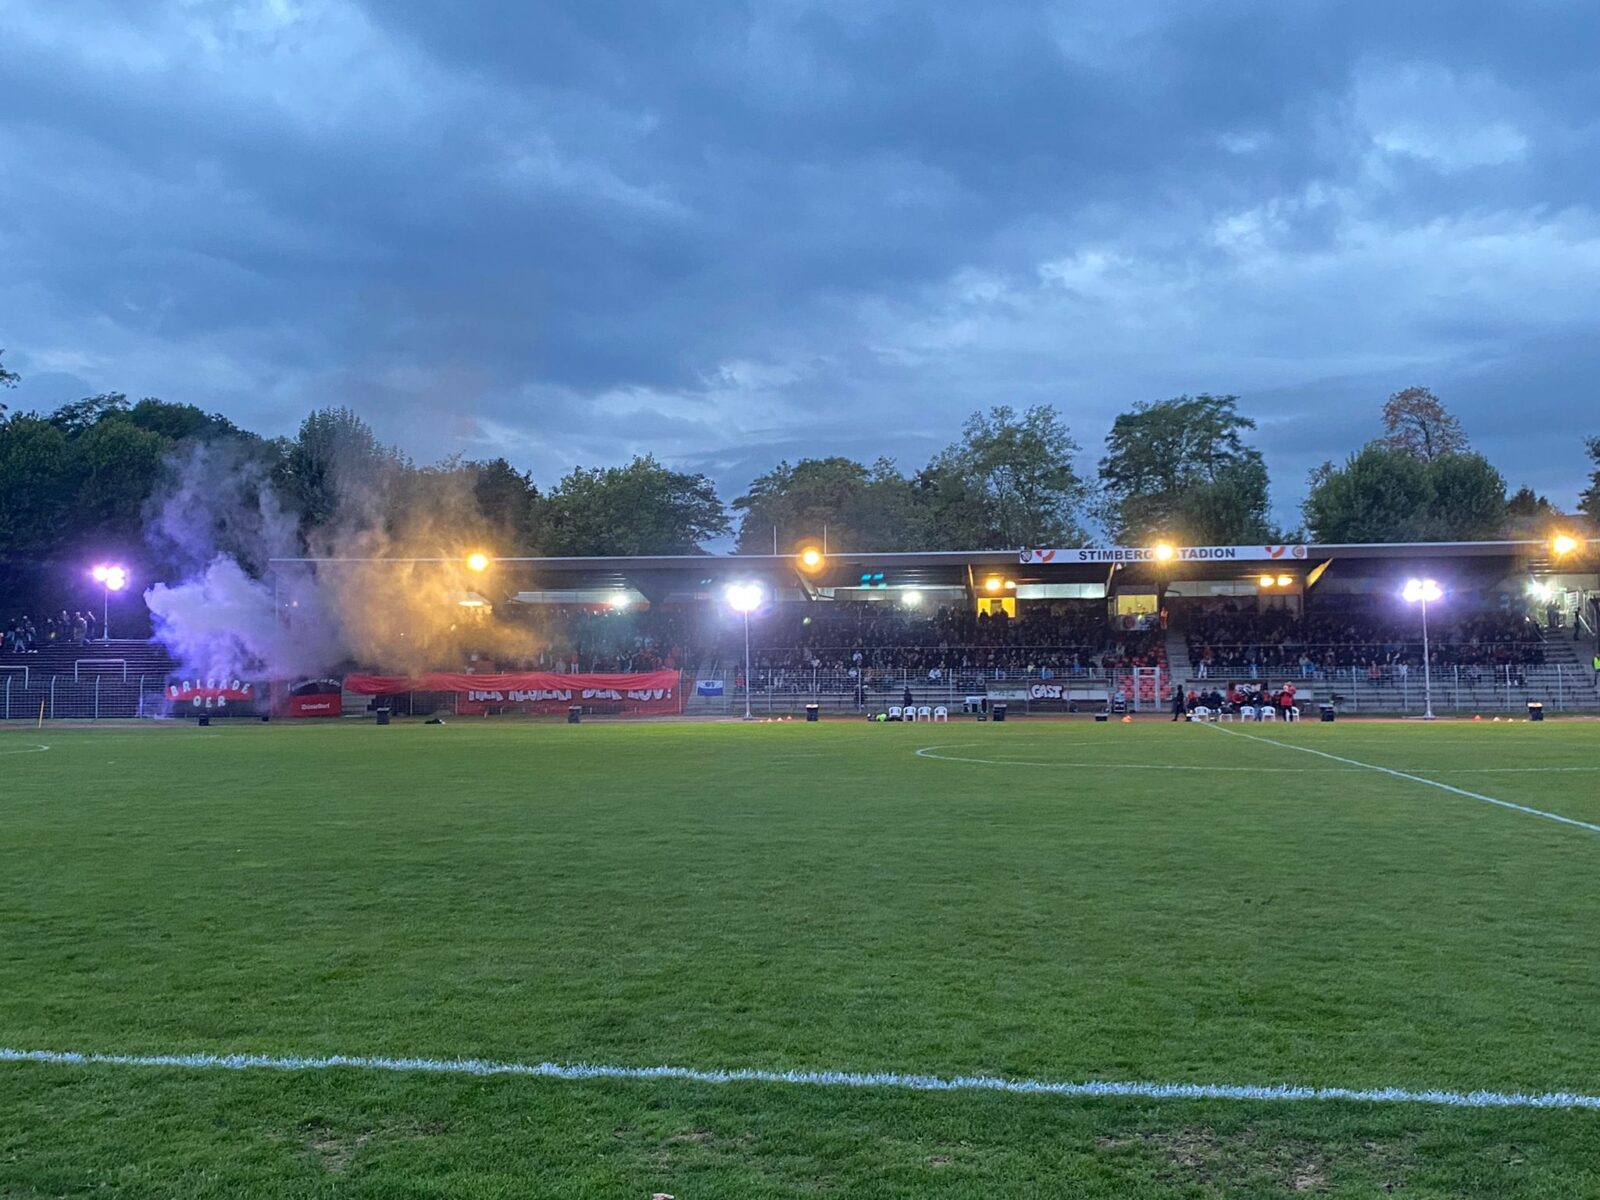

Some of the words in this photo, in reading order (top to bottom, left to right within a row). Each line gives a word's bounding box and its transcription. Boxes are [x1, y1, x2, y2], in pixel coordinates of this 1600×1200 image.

[1079, 550, 1153, 561] STIMBERG
[1172, 548, 1236, 559] TADION
[170, 679, 250, 697] BRIGADE
[1031, 684, 1063, 699] GAST
[193, 696, 226, 708] OER
